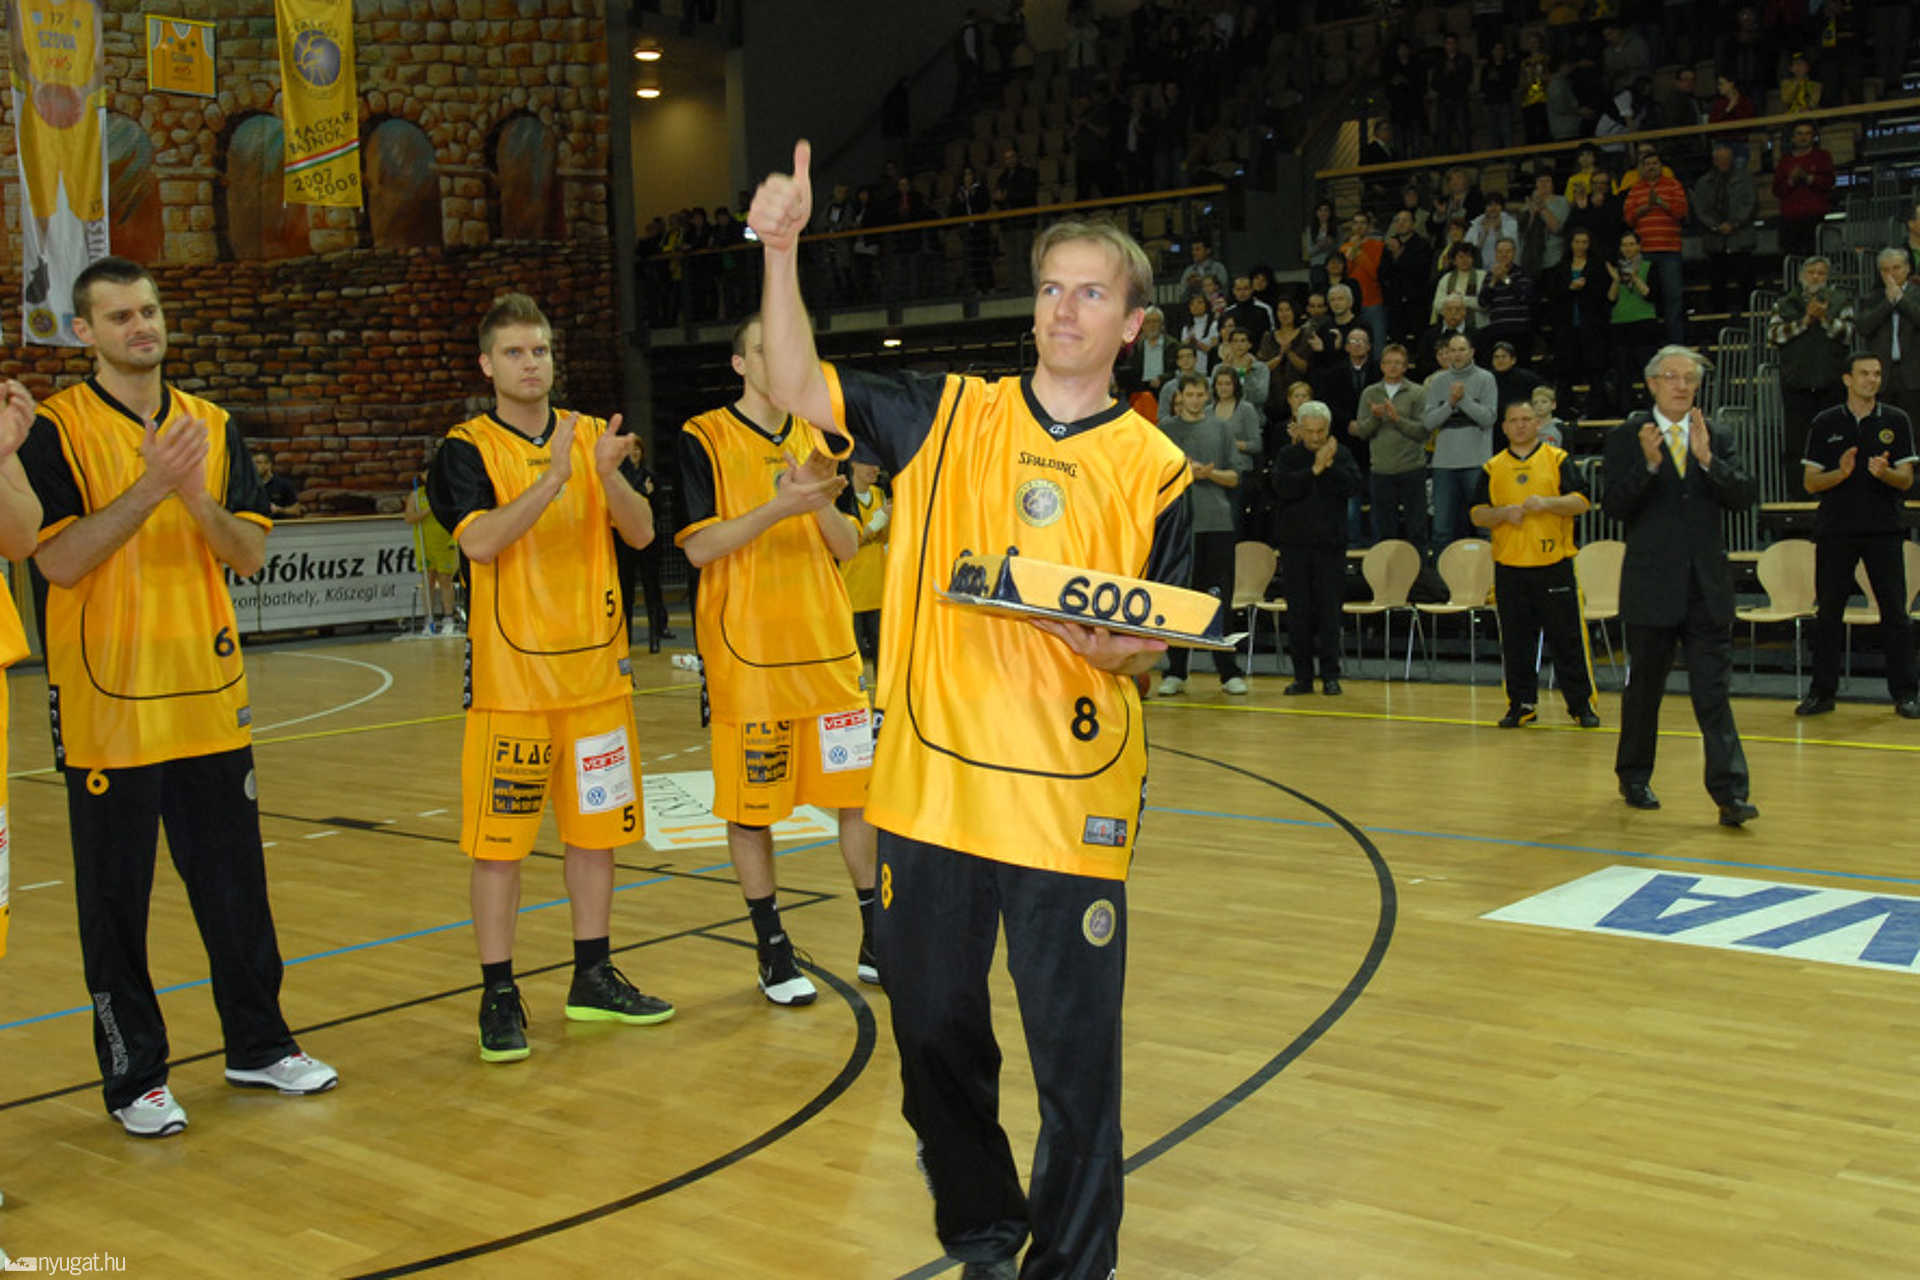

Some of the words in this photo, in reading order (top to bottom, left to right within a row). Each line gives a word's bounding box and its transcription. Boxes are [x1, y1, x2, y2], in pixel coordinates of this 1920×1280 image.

[295, 167, 333, 192] 2007
[313, 173, 359, 200] 2008
[1018, 451, 1078, 480] SPALDING
[1540, 539, 1556, 553] 17
[606, 589, 616, 618] 5
[1059, 575, 1165, 627] 600.
[214, 627, 235, 657] 6
[1071, 697, 1099, 741] 8
[622, 804, 637, 832] 5
[881, 862, 893, 910] 8
